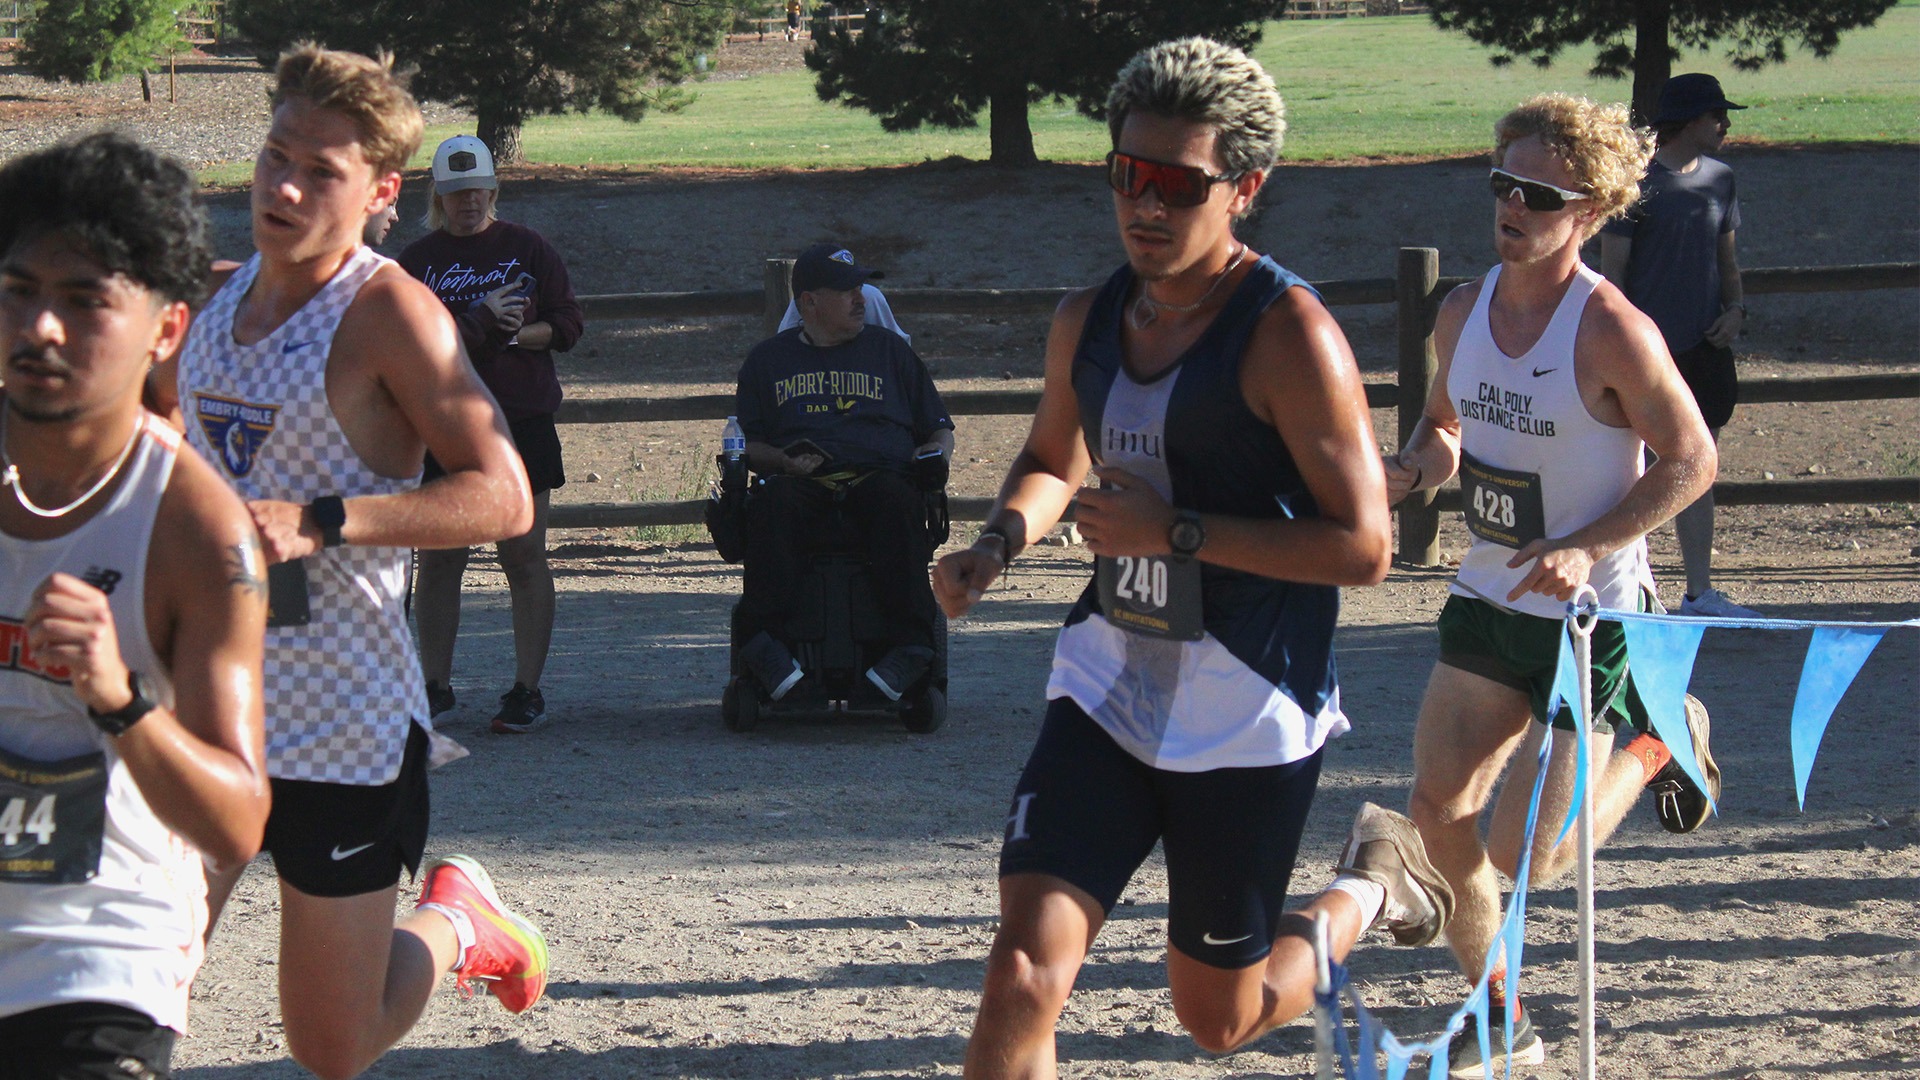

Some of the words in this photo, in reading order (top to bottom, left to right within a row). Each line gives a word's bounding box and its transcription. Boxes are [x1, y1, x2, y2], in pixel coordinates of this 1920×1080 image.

[424, 258, 520, 293] Westmont
[442, 291, 491, 303] COLLEG
[775, 371, 883, 407] EMBRY-RIDDLE
[1478, 382, 1502, 406] CAL
[806, 404, 829, 413] DAD
[1461, 399, 1515, 431] DISTANCE
[1518, 416, 1555, 437] CLUB
[1473, 485, 1516, 528] 428
[1116, 556, 1168, 608] 240
